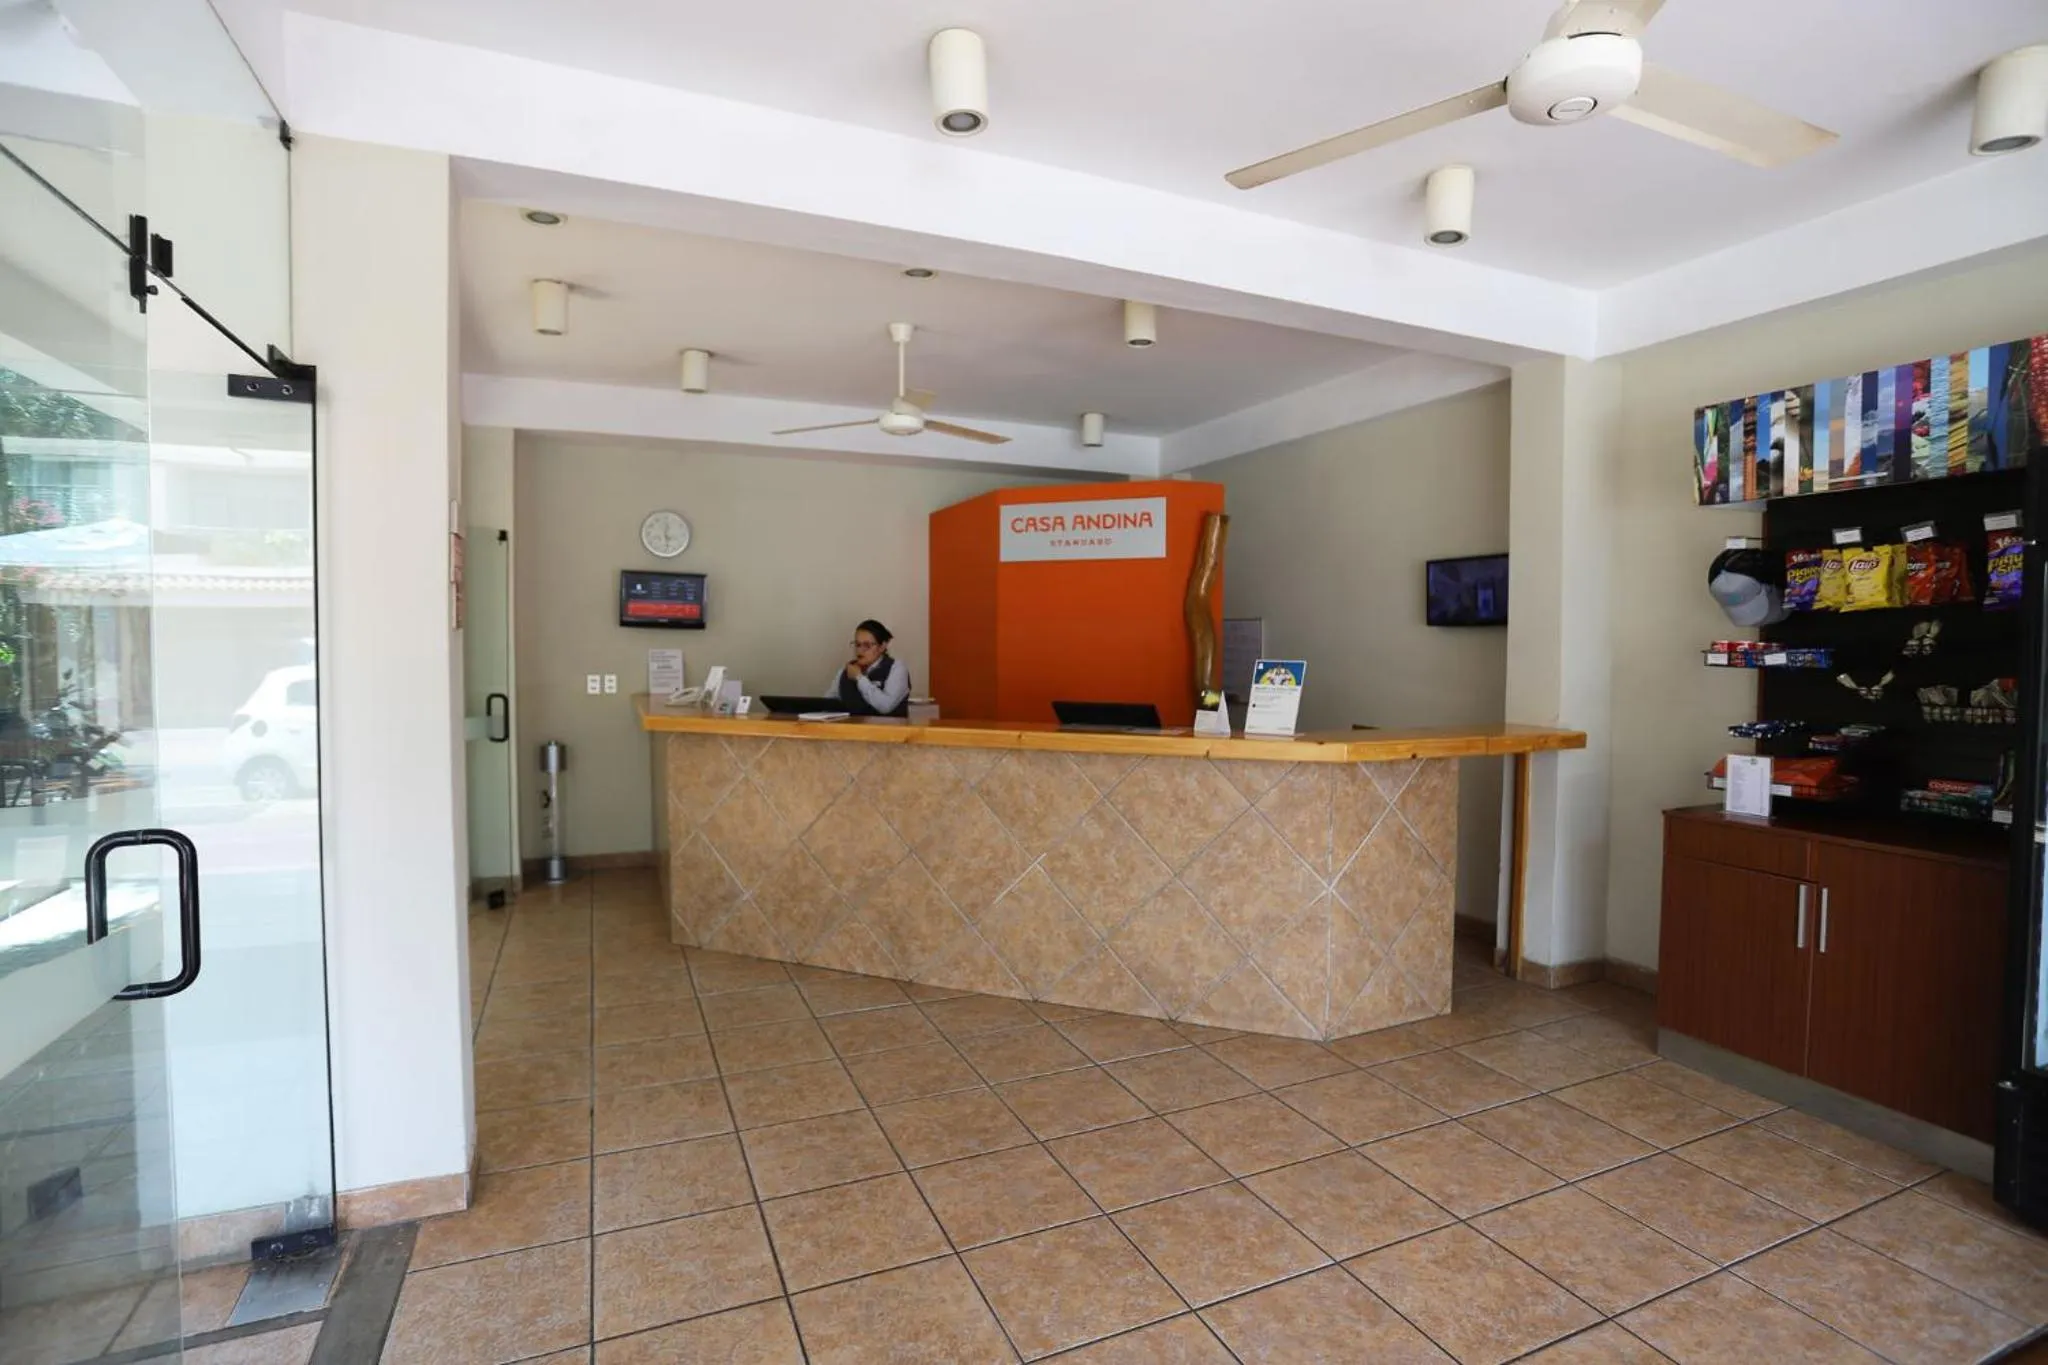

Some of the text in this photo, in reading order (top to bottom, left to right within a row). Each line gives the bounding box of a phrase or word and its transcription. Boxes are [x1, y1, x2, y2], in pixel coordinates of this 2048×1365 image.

[1010, 511, 1154, 534] CASA ANDINA
[1049, 537, 1113, 548] STANDARD
